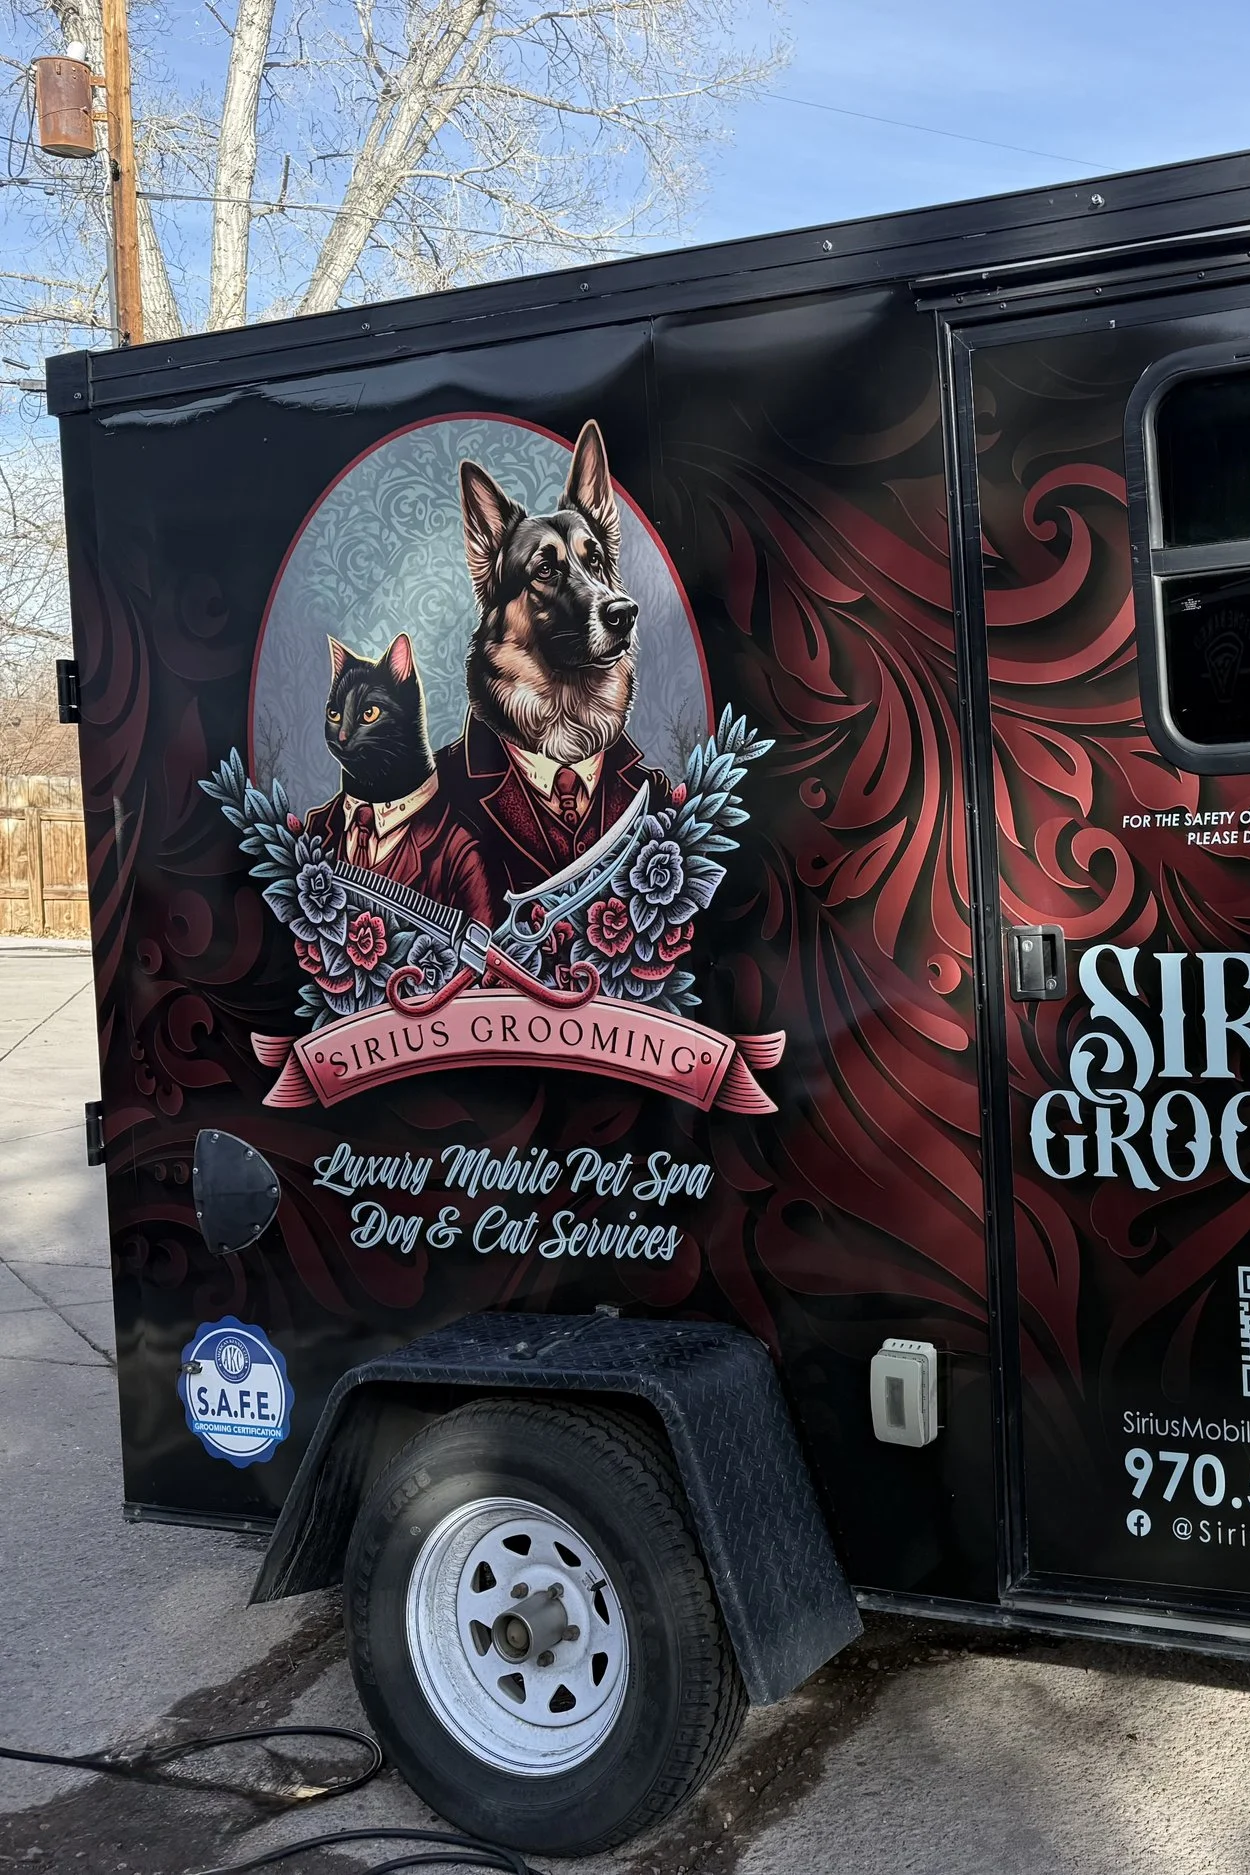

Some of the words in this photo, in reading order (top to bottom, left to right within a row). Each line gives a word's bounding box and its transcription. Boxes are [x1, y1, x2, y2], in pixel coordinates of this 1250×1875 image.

[1122, 815, 1151, 829] FOR
[1154, 814, 1180, 828] THE
[1184, 811, 1235, 826] SAFETY
[1187, 831, 1238, 846] PLEASE
[329, 1021, 450, 1078] SIRIUS
[471, 1015, 696, 1075] GROOMING
[313, 1142, 433, 1197] Luxury
[441, 1144, 563, 1199] Mobile
[566, 1147, 634, 1197] Pet
[633, 1151, 714, 1206] Spa
[350, 1201, 424, 1254] Dog
[426, 1206, 463, 1248] &
[473, 1205, 538, 1254] Cat
[538, 1210, 684, 1261] Services
[223, 1346, 244, 1373] AKC
[197, 1386, 276, 1421] S.A.F.E.
[194, 1422, 232, 1433] GROOMING
[232, 1425, 282, 1438] CERTIFICATION
